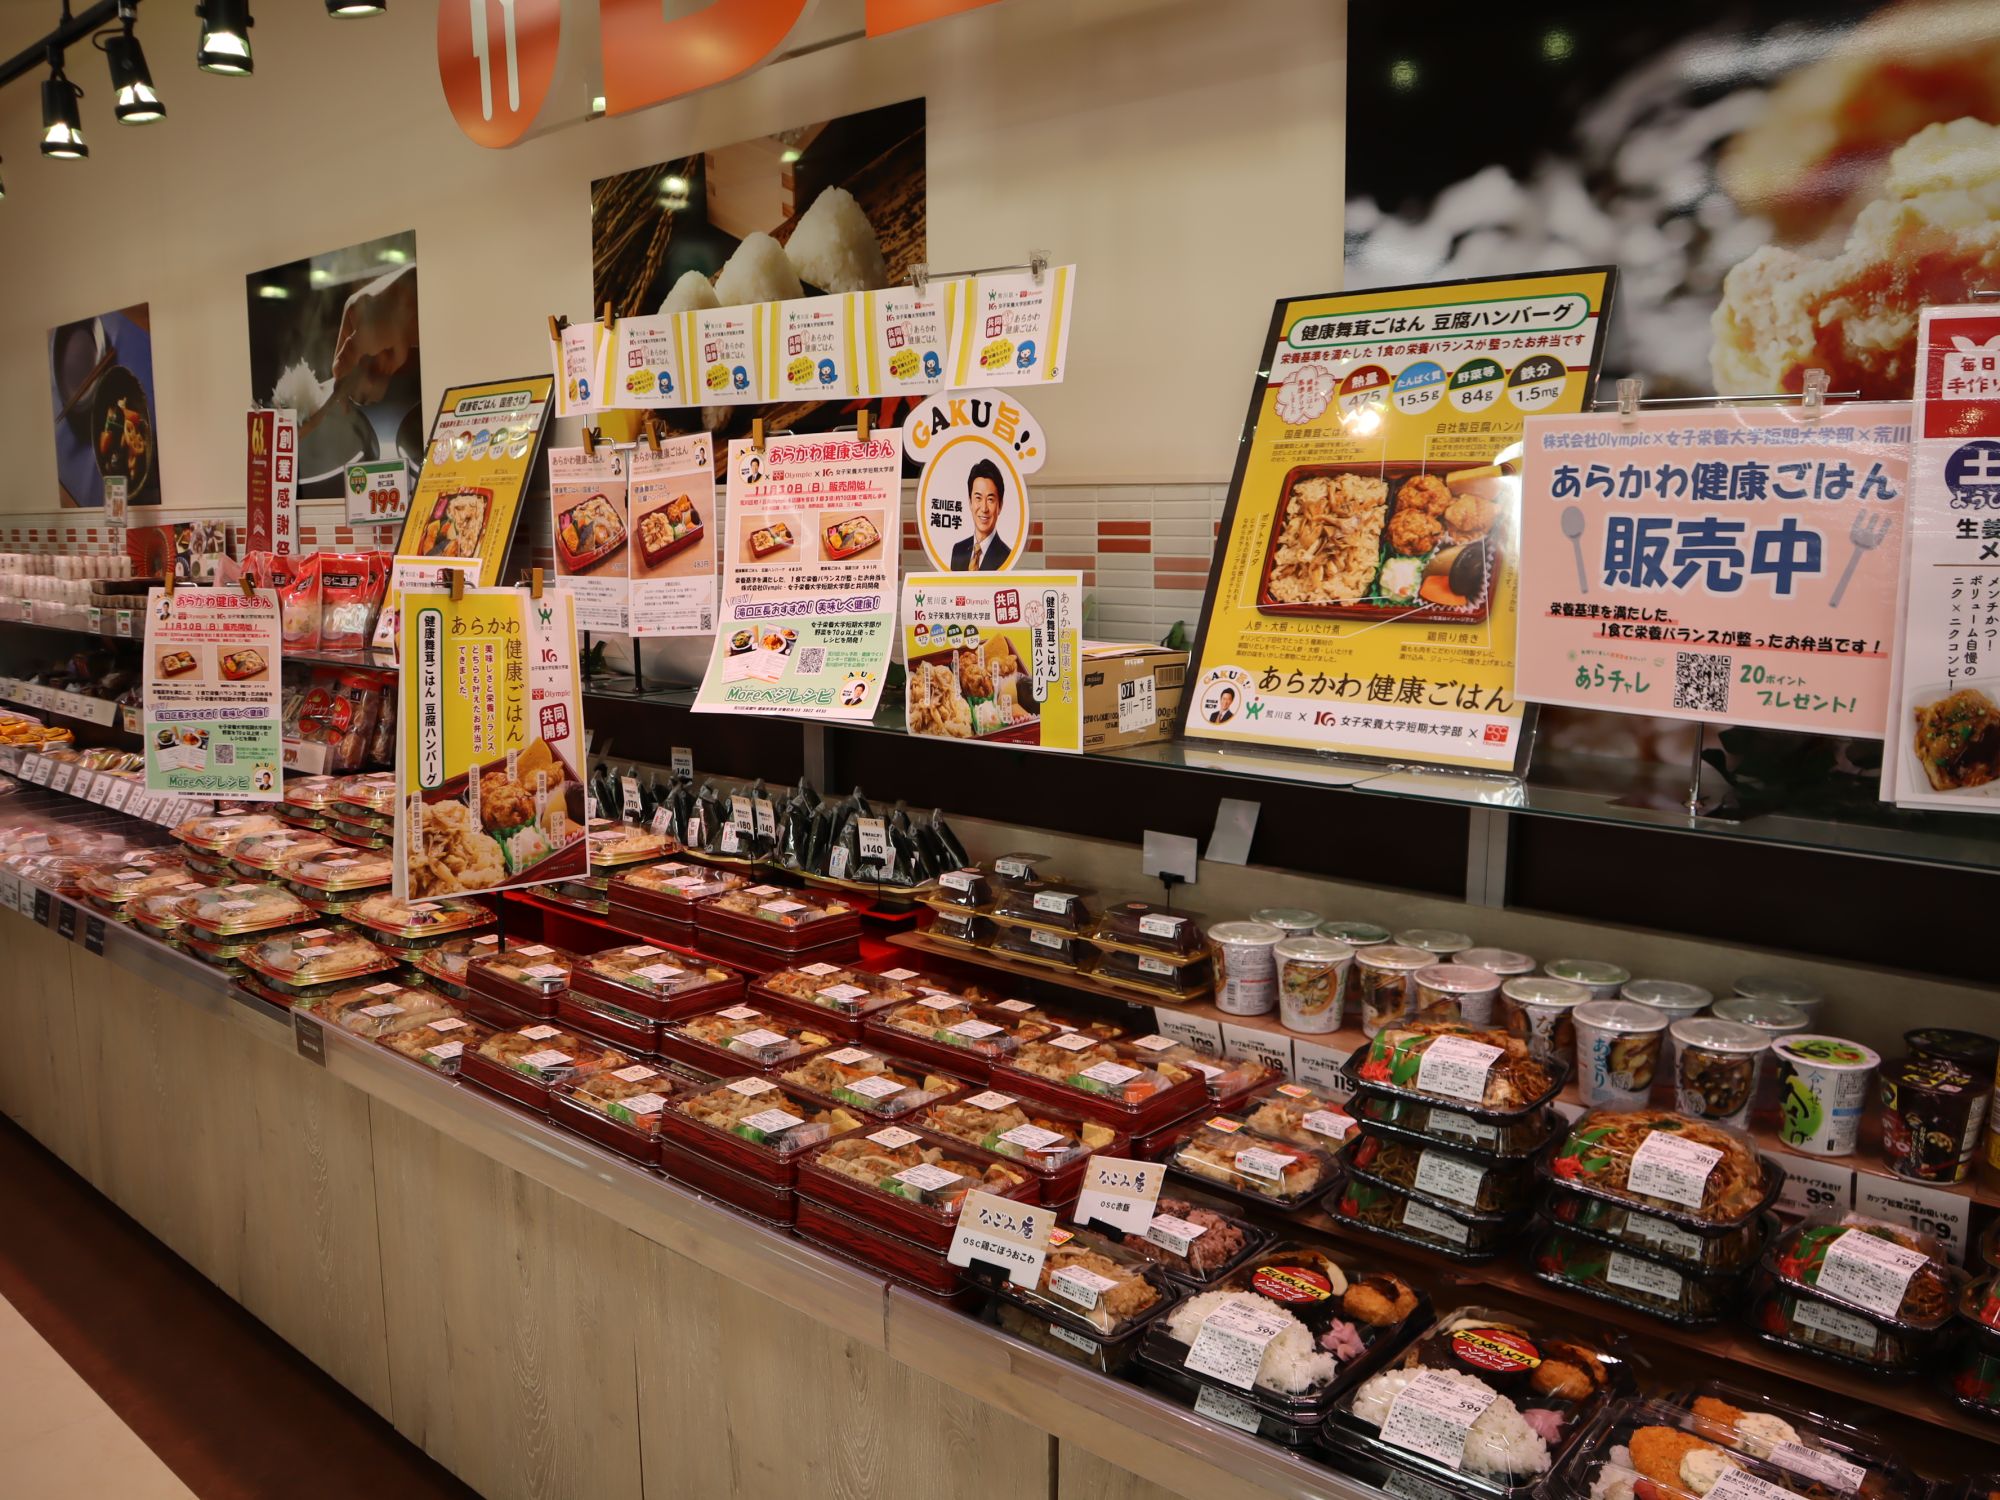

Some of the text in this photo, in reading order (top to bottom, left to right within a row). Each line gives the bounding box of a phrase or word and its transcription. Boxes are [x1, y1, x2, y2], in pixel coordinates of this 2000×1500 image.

[1301, 302, 1574, 341] 健康舞茸ごはん 豆腐ハンバーグ
[1520, 363, 1552, 381] 鉄分
[1961, 357, 1995, 372] 毎日
[1352, 372, 1379, 389] 熱量
[1397, 371, 1442, 389] たんぱく質
[1457, 366, 1496, 384] 野菜等
[1349, 391, 1381, 406] 475
[1399, 389, 1439, 407] 15.5g
[1462, 389, 1494, 405] 84g
[1516, 385, 1558, 403] 1.5mg
[633, 448, 689, 463] あらかわ健康ごはん
[769, 440, 896, 465] あらかわ健康ごはん
[1552, 461, 1898, 500] あらかわ健康ごはん
[931, 499, 963, 512] 荒川区長
[931, 512, 963, 530] 滝口学
[1603, 516, 1822, 595] 販売中
[323, 576, 358, 588] 杏仁豆腐
[176, 594, 273, 609] あらかわ健康ごはん
[996, 592, 1018, 607] 共同
[928, 611, 990, 620] 女子栄養大学短期大学部
[1551, 602, 1675, 623] 栄養基準を満たした、
[1985, 577, 2000, 651] メンチかつ！
[451, 616, 521, 636] あらかわ
[1964, 575, 1983, 677] ボリューム自慢の
[1045, 596, 1058, 678] 健康舞茸ごはん
[1060, 591, 1072, 705] あらかわ健康ごはん
[1033, 628, 1044, 696] 豆腐ハンバーグ
[1576, 663, 1650, 693] あらチャレ
[472, 645, 481, 752] どちらも叶えたお弁当が
[505, 638, 524, 742] 健康ごはん
[545, 690, 570, 698] Olympic
[726, 686, 835, 704] Moreベジレシピ
[1121, 682, 1134, 698] 071
[424, 616, 437, 786] 健康舞茸ごはん 豆腐ハンバーグ
[542, 708, 565, 725] 共同
[1266, 709, 1292, 721] 荒川区
[1341, 715, 1463, 737] 女子栄養大学短期大学部
[168, 775, 250, 790] Moreベジレシピ
[1258, 1054, 1284, 1071] 109
[1334, 1075, 1357, 1092] 119
[1099, 1170, 1146, 1193] なごみ庵
[1806, 1188, 1835, 1204] 99
[979, 1208, 1035, 1240] なごみ庵
[1255, 1327, 1275, 1336] 599
[1458, 1401, 1481, 1413] 599
